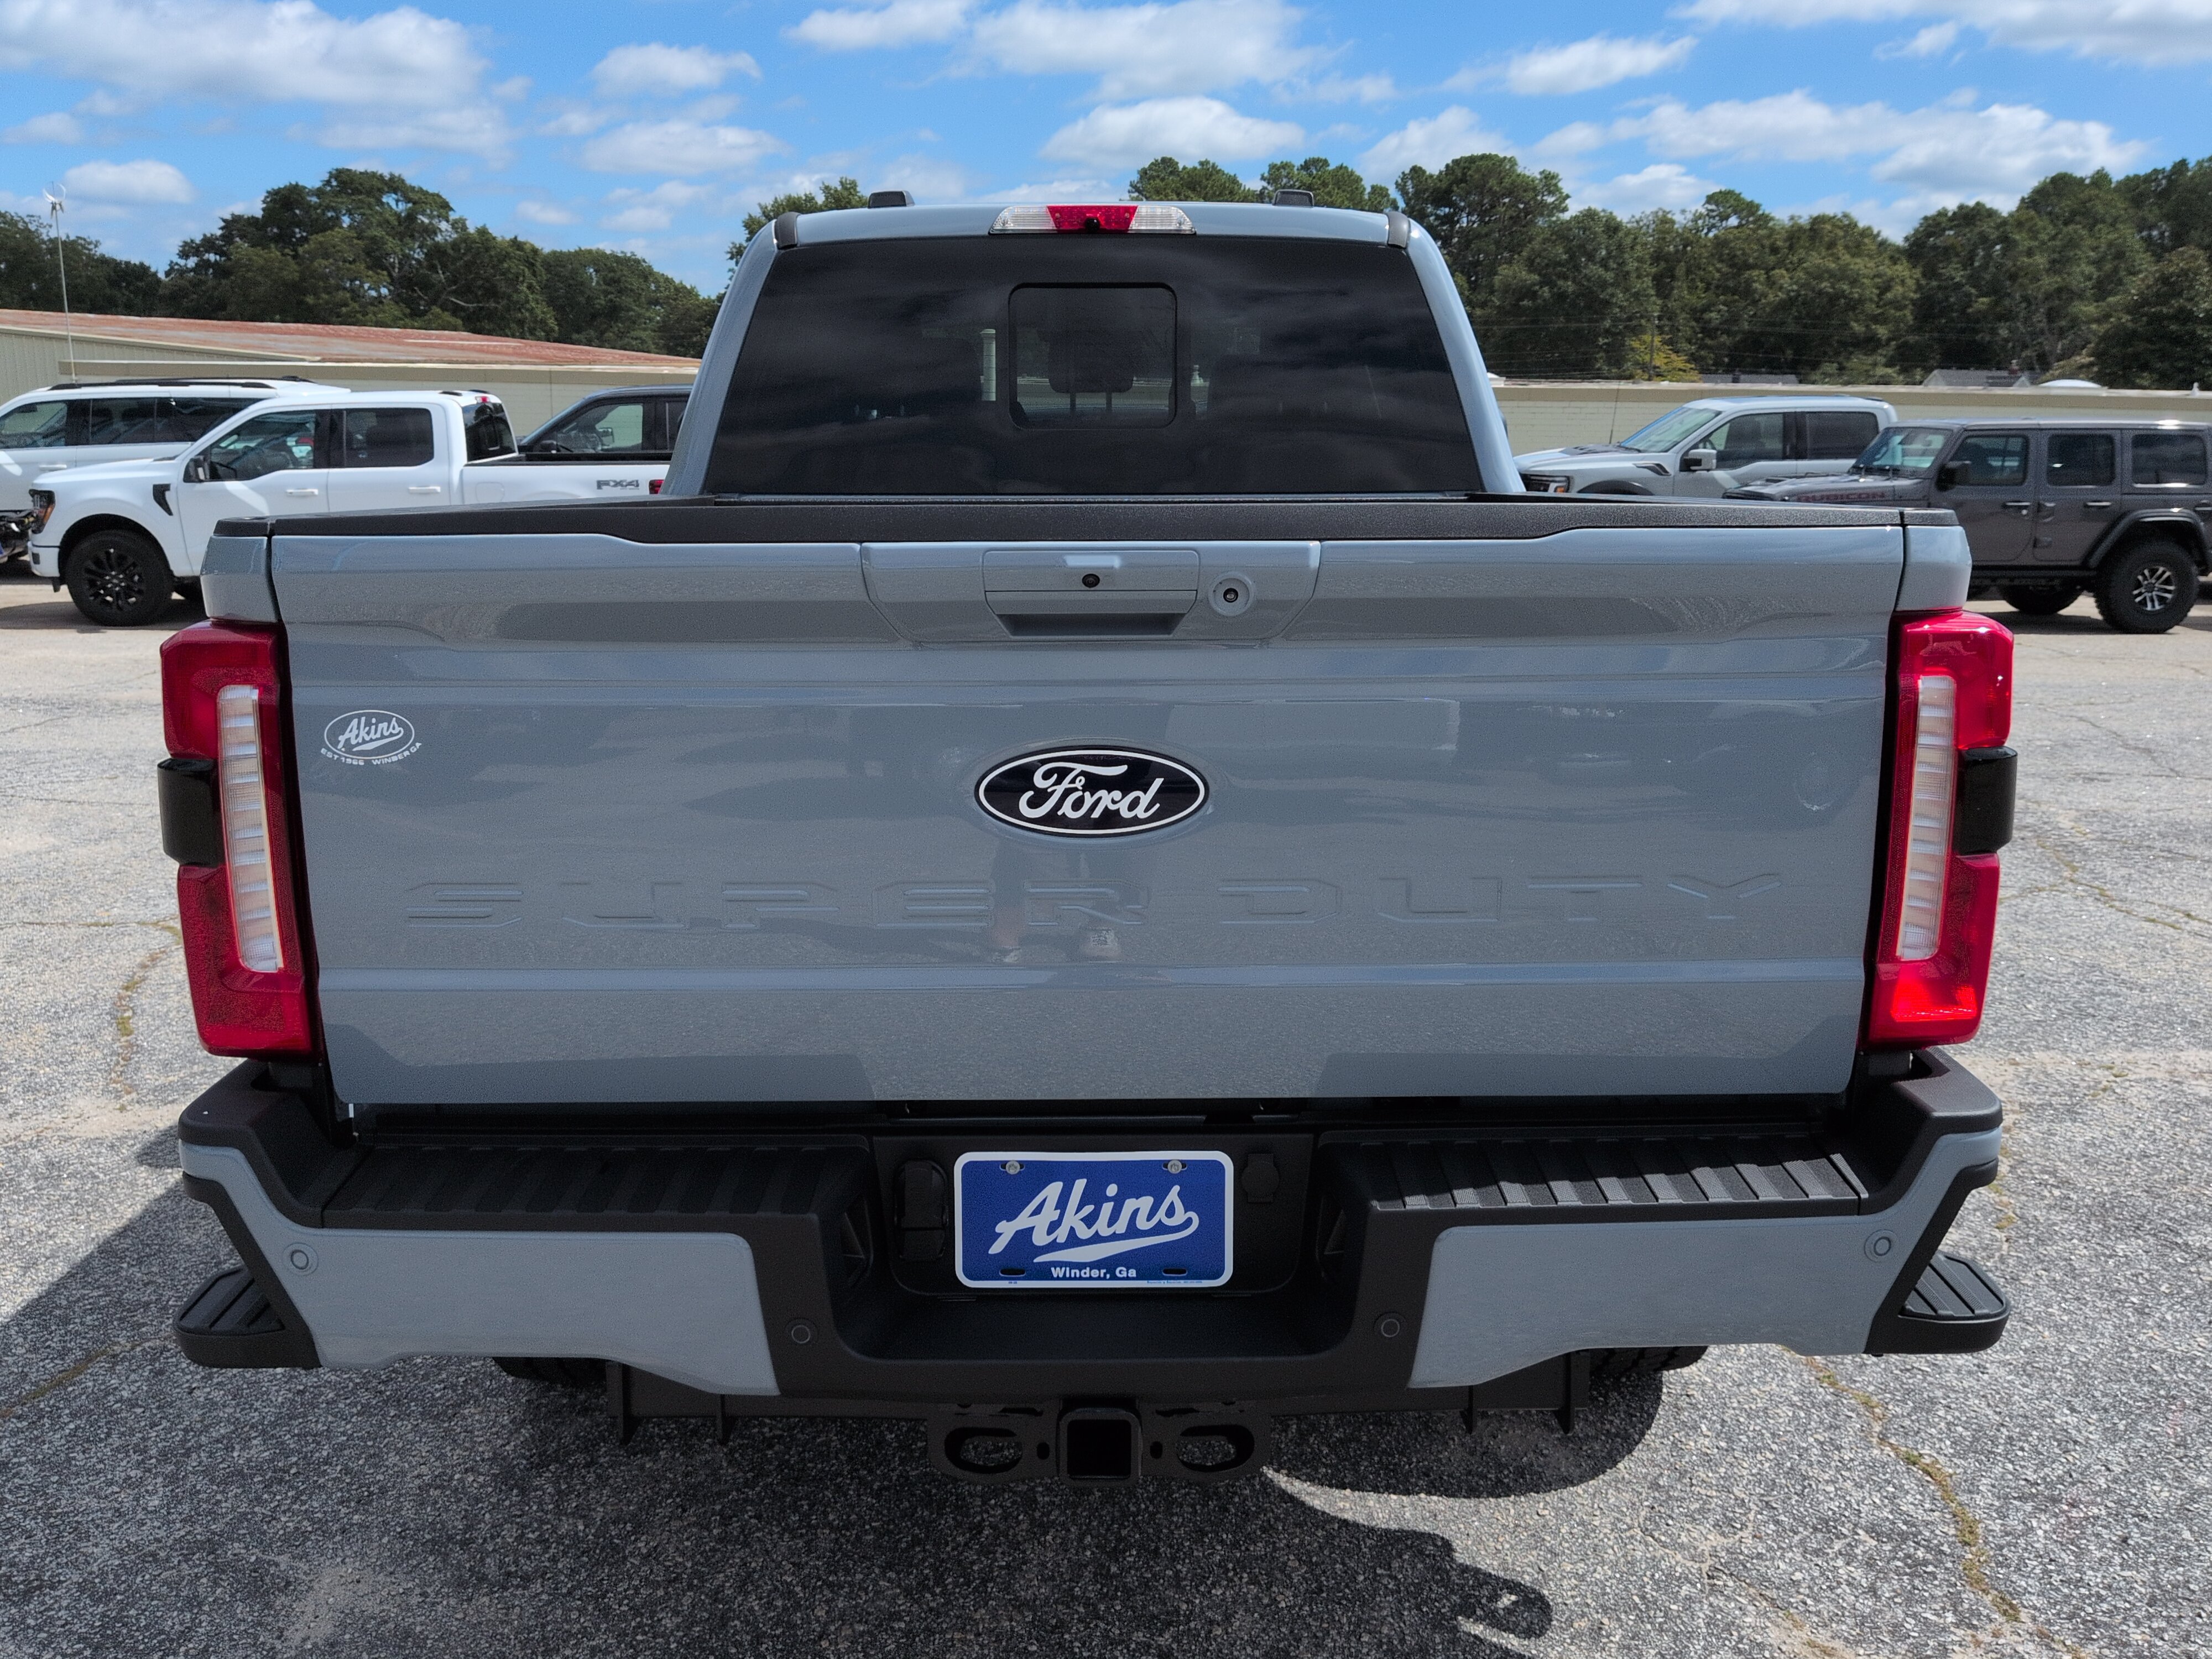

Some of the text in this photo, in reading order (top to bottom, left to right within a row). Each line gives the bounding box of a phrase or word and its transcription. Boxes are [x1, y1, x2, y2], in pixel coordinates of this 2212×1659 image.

[596, 479, 639, 490] FX4
[337, 717, 404, 751] Akins
[321, 748, 339, 760] EST
[372, 750, 410, 765] WINDER
[410, 742, 422, 753] GA
[1019, 761, 1164, 818] Ford
[405, 873, 1783, 929] SUPER DUTY
[988, 1178, 1199, 1262] Akins
[1051, 1267, 1136, 1279] Winder, Ga
